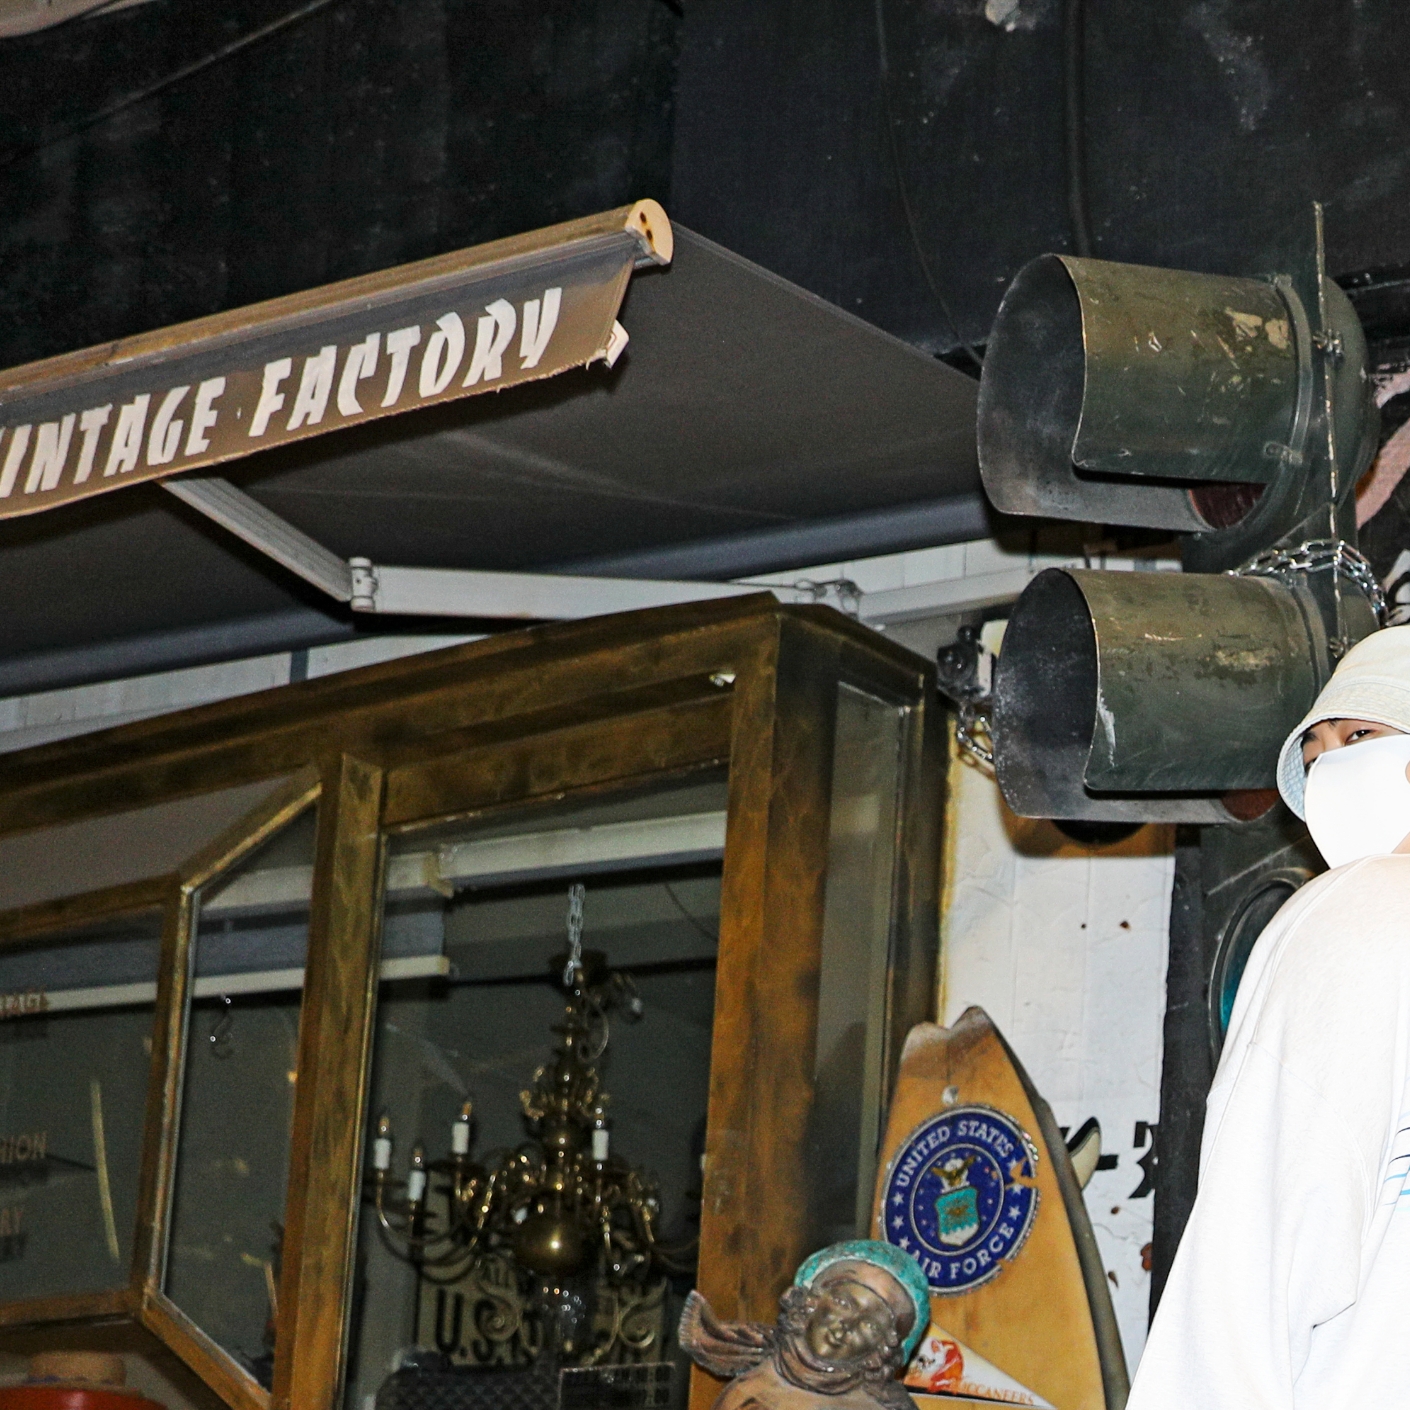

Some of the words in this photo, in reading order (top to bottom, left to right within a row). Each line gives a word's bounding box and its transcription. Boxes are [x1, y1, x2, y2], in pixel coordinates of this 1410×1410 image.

[0, 377, 226, 498] INTAGE
[249, 287, 562, 437] FACTORY
[895, 1125, 951, 1188] UNITED
[957, 1119, 1015, 1158] STATES
[949, 1222, 1015, 1280] FORCE
